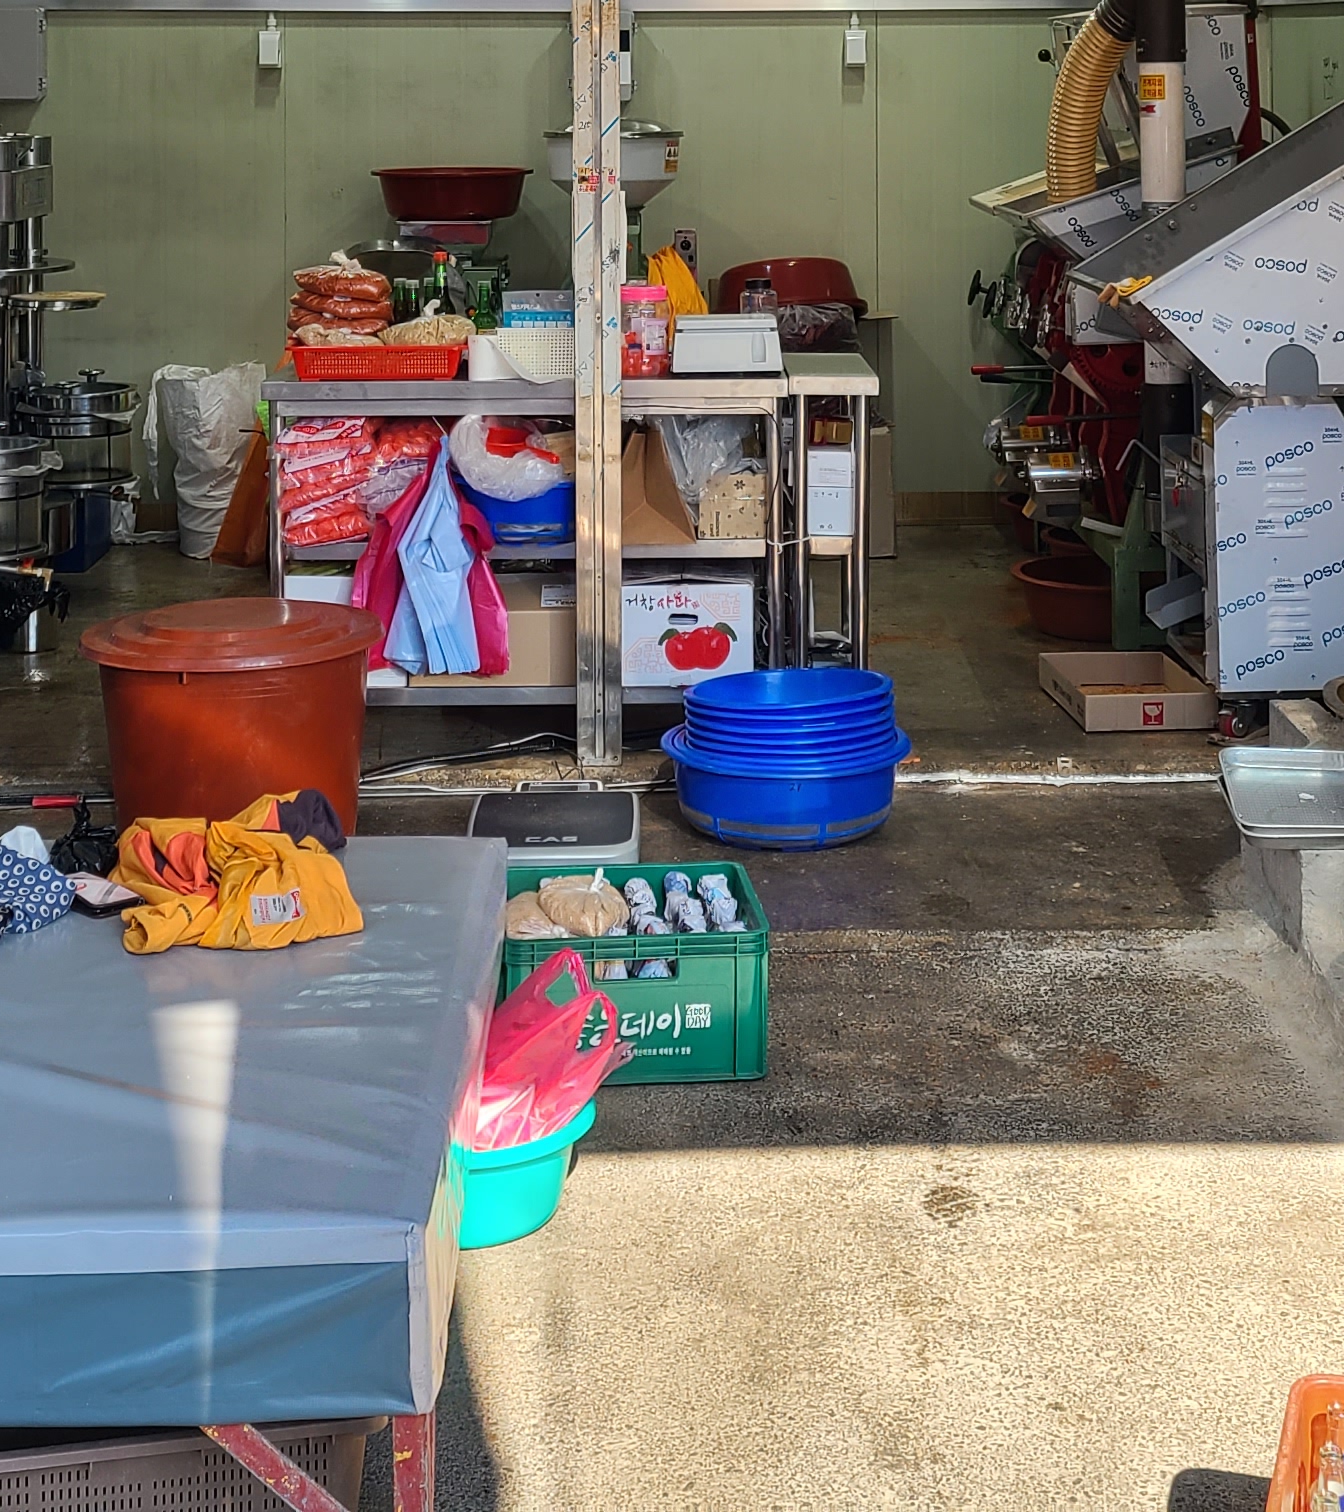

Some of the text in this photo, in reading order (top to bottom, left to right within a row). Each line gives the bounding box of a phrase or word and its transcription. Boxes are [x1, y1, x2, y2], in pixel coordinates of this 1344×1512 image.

[1255, 256, 1307, 274] posco
[1243, 318, 1296, 336] posco
[1265, 441, 1314, 471] posco
[1284, 499, 1333, 529] posco
[1255, 524, 1276, 532] posco
[625, 593, 656, 612] 거창
[1218, 591, 1266, 621] posco
[1293, 641, 1314, 649] posco
[1236, 649, 1285, 680] posco
[524, 835, 578, 843] CAS
[686, 1016, 710, 1028] DAY
